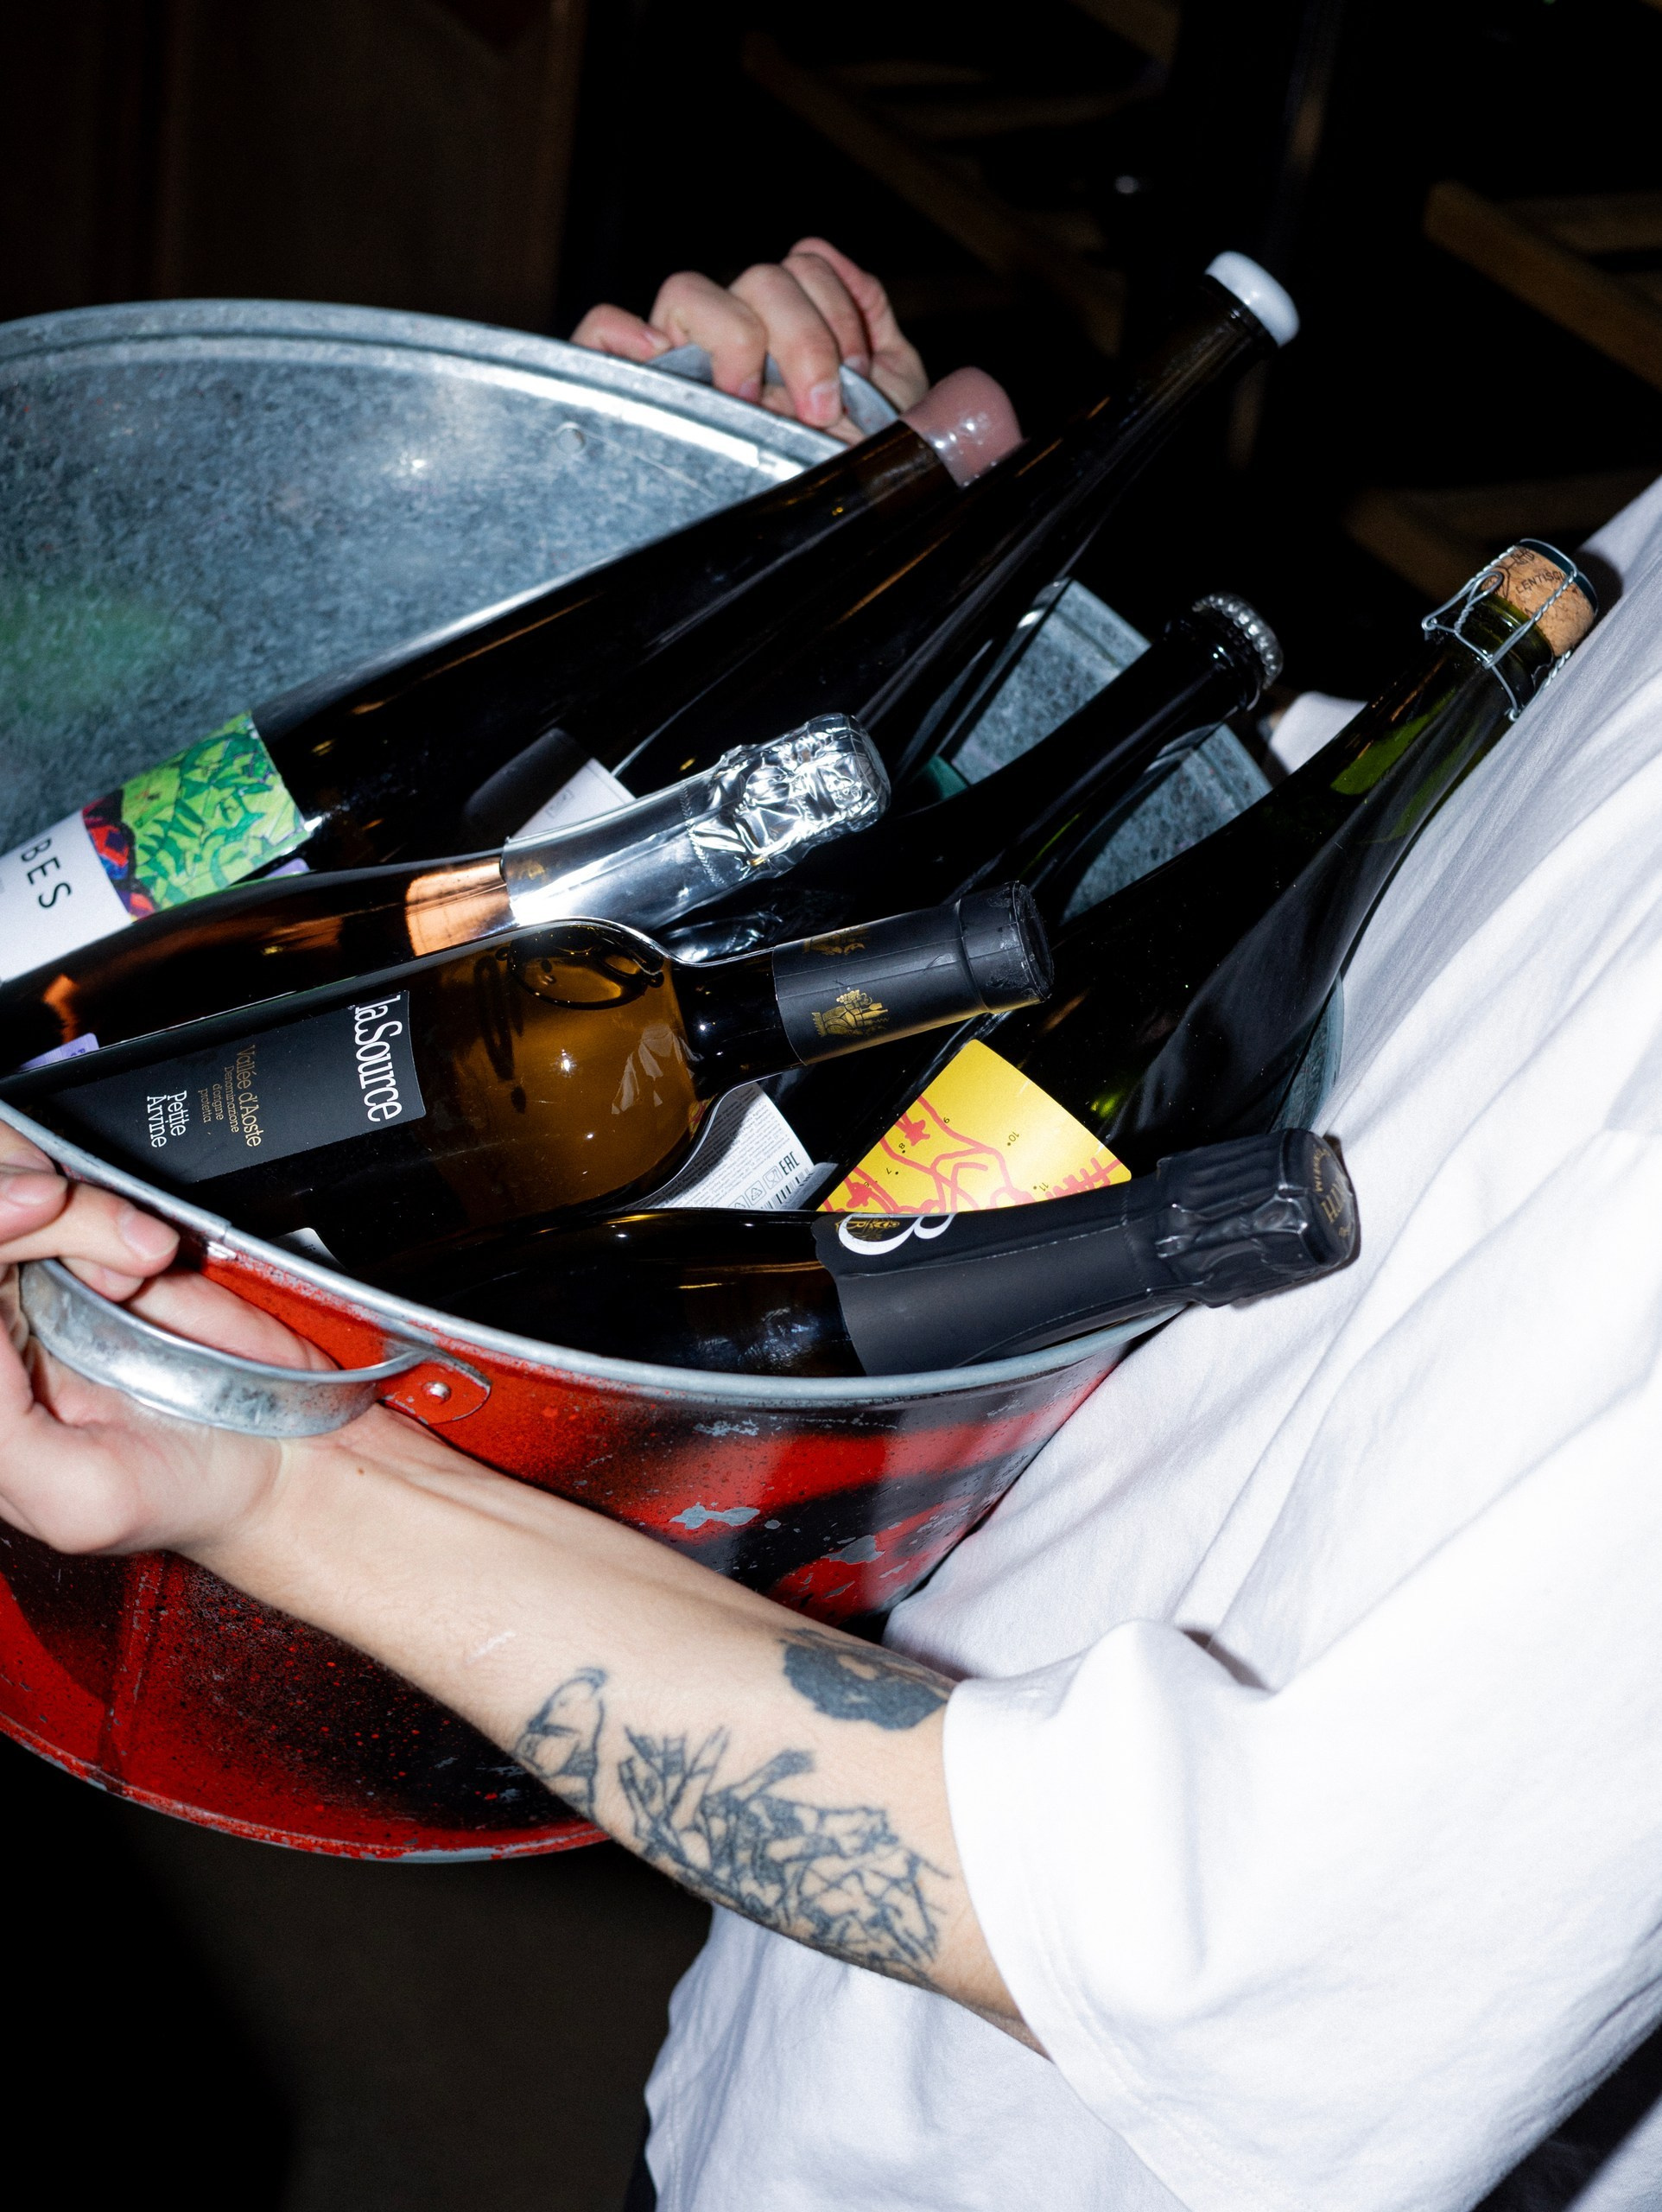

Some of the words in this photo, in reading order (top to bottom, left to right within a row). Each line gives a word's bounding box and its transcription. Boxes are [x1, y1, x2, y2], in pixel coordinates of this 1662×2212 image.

[236, 1045, 257, 1089] Vallée
[147, 1095, 169, 1147] Arvine
[167, 1090, 190, 1136] Petite
[198, 1088, 213, 1123] protetta
[225, 1065, 239, 1133] Denominazione
[238, 1092, 264, 1147] d'Aoste
[1008, 1131, 1019, 1142] 10
[1039, 1182, 1050, 1192] 11
